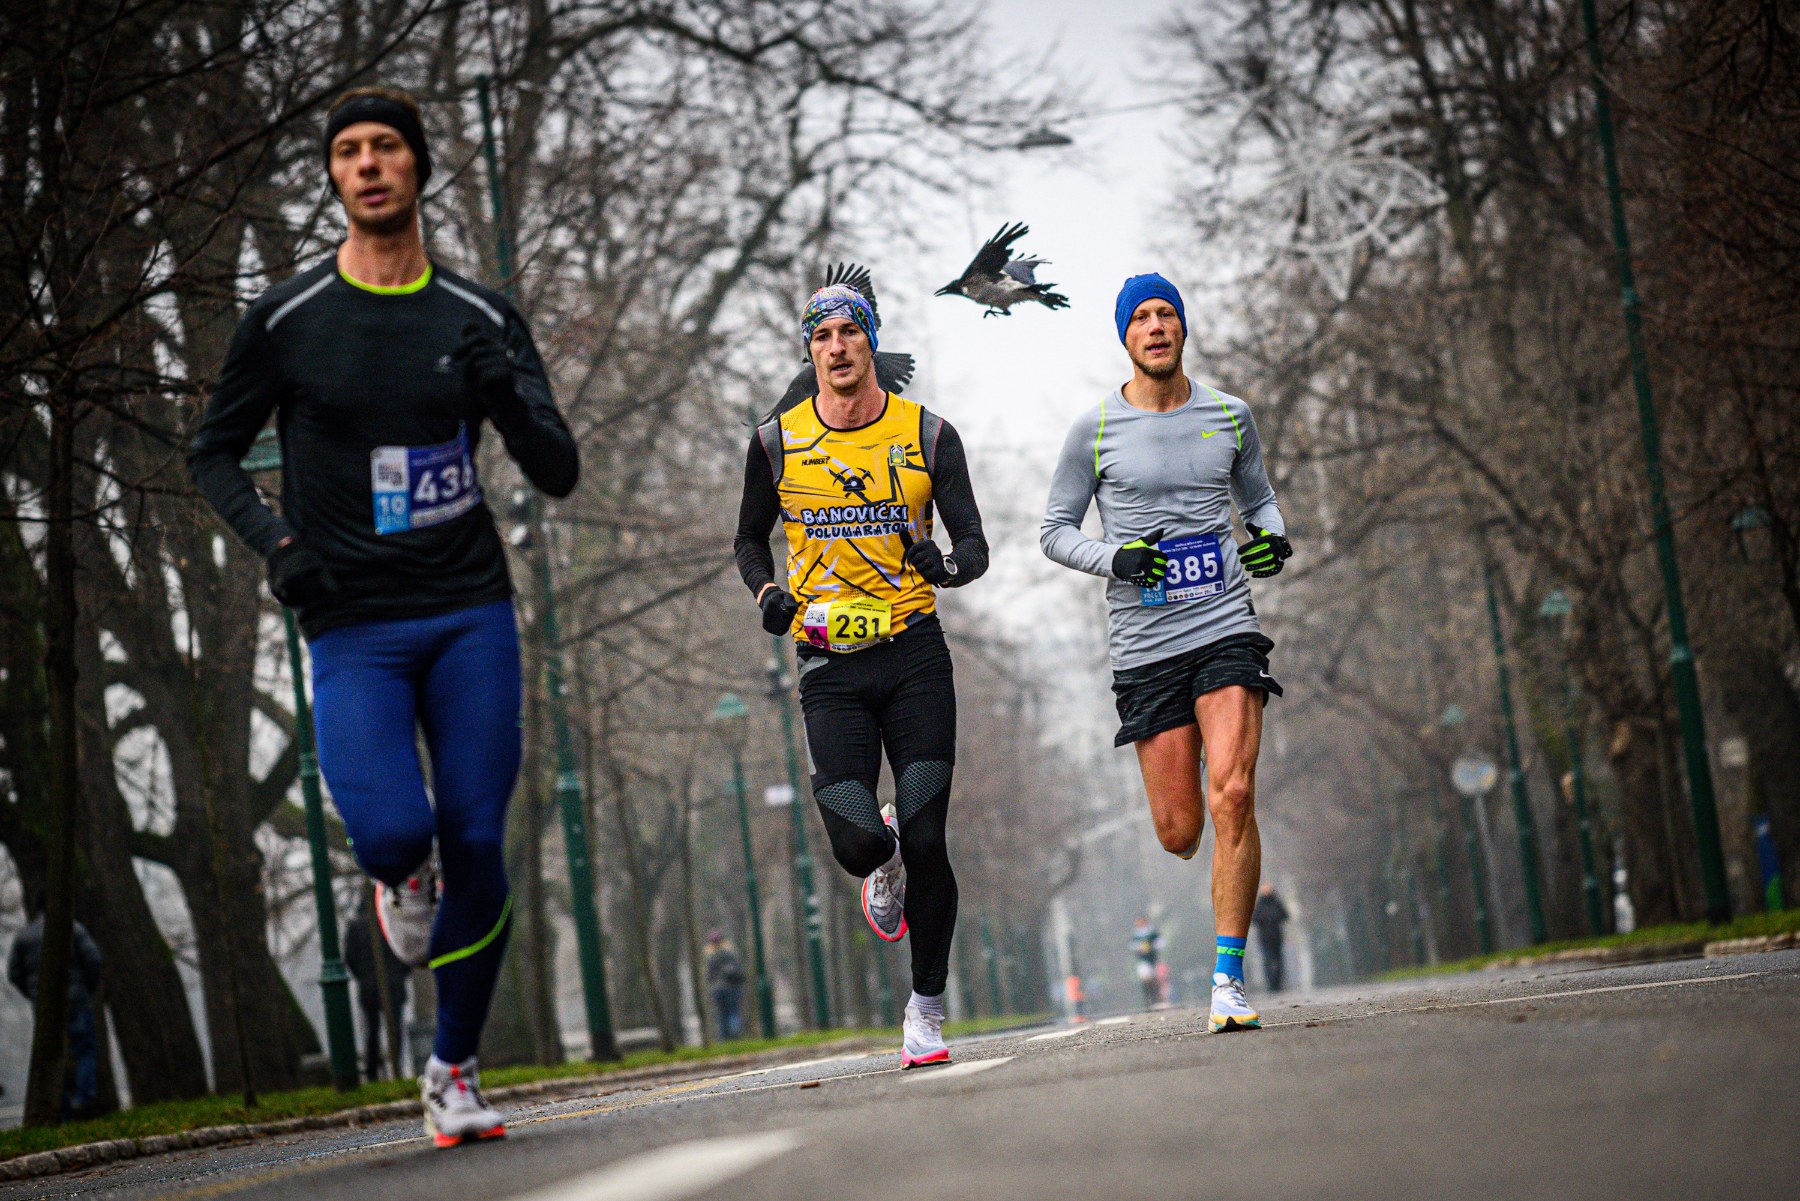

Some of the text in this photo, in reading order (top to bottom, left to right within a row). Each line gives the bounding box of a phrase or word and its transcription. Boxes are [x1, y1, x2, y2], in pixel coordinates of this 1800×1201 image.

[801, 502, 908, 526] BANOVIĆKI
[804, 522, 909, 540] POLUMARATON
[1166, 552, 1218, 585] 385
[835, 614, 880, 639] 231
